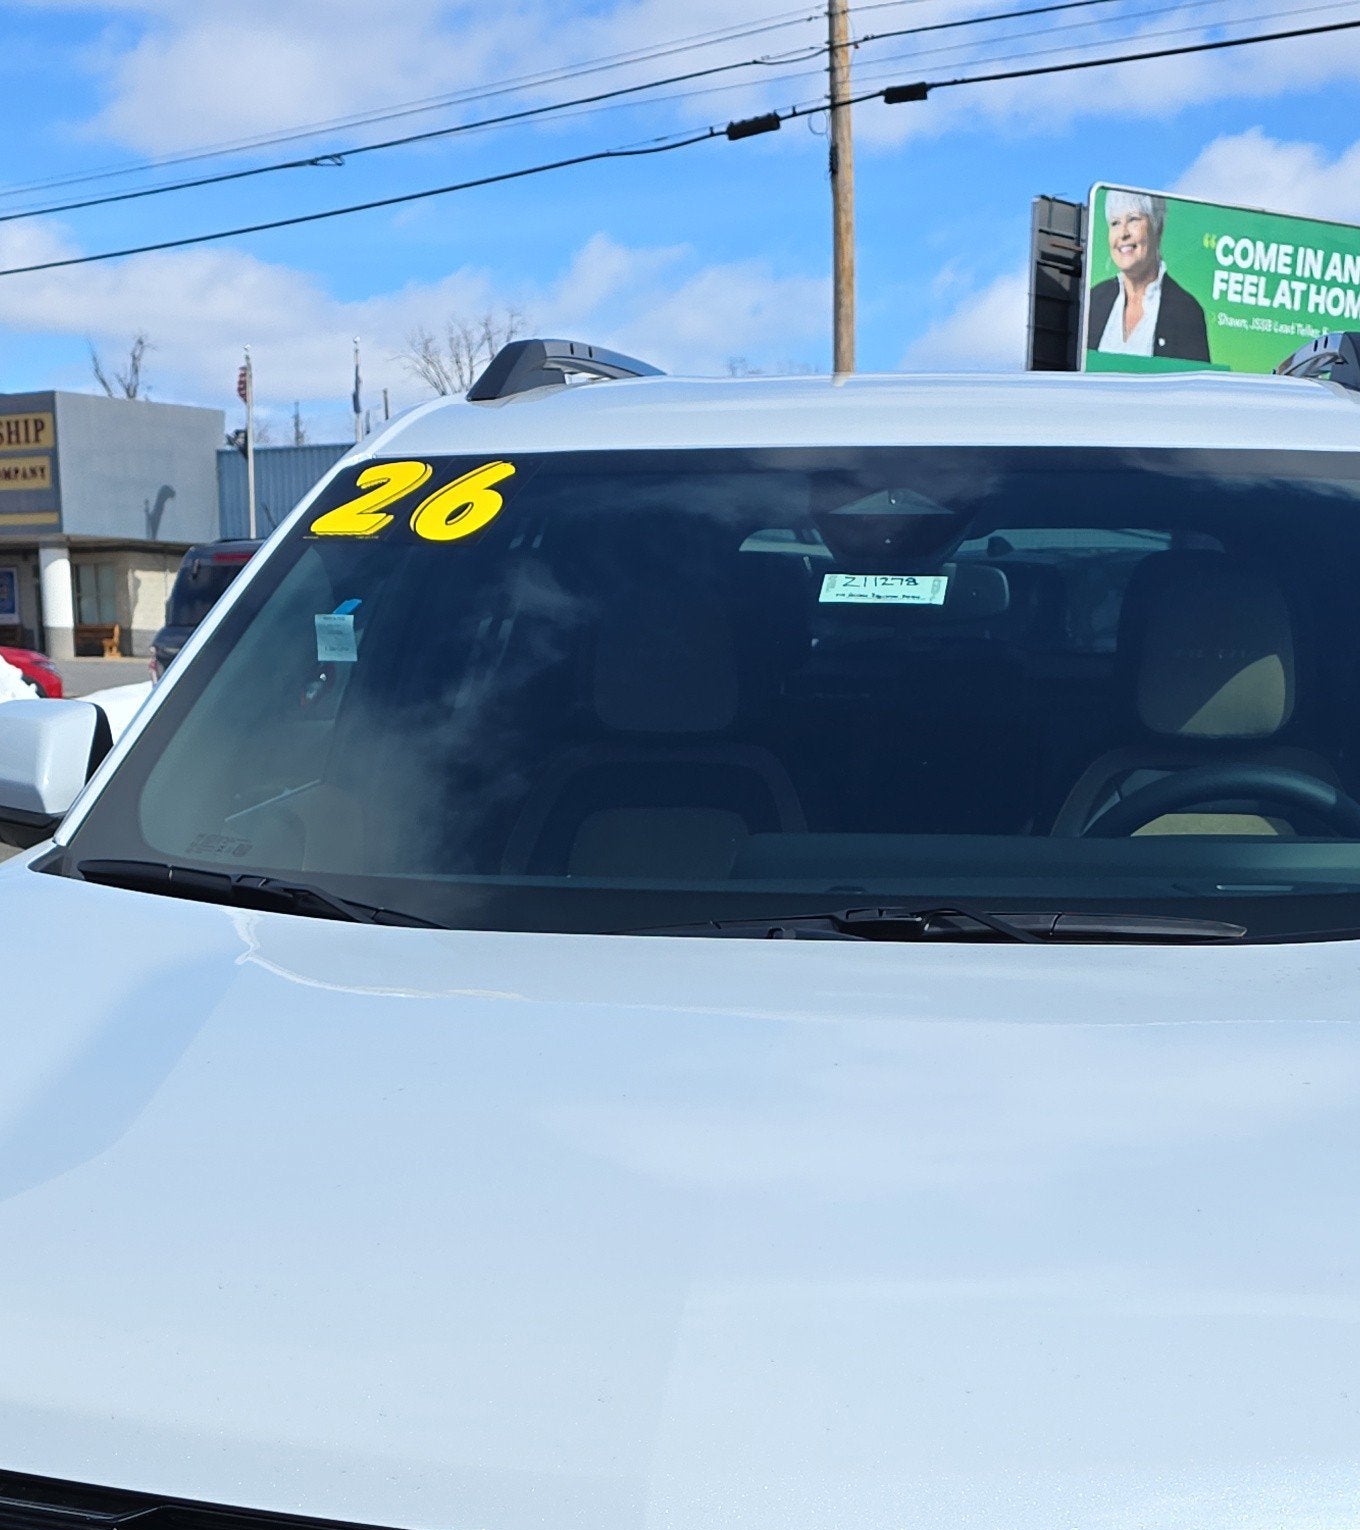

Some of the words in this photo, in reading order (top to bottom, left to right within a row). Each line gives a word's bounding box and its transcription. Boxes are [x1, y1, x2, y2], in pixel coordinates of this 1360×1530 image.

[1295, 247, 1325, 281] IN
[1212, 270, 1271, 307] FEEL
[1272, 279, 1308, 311] AT
[310, 461, 516, 541] 26
